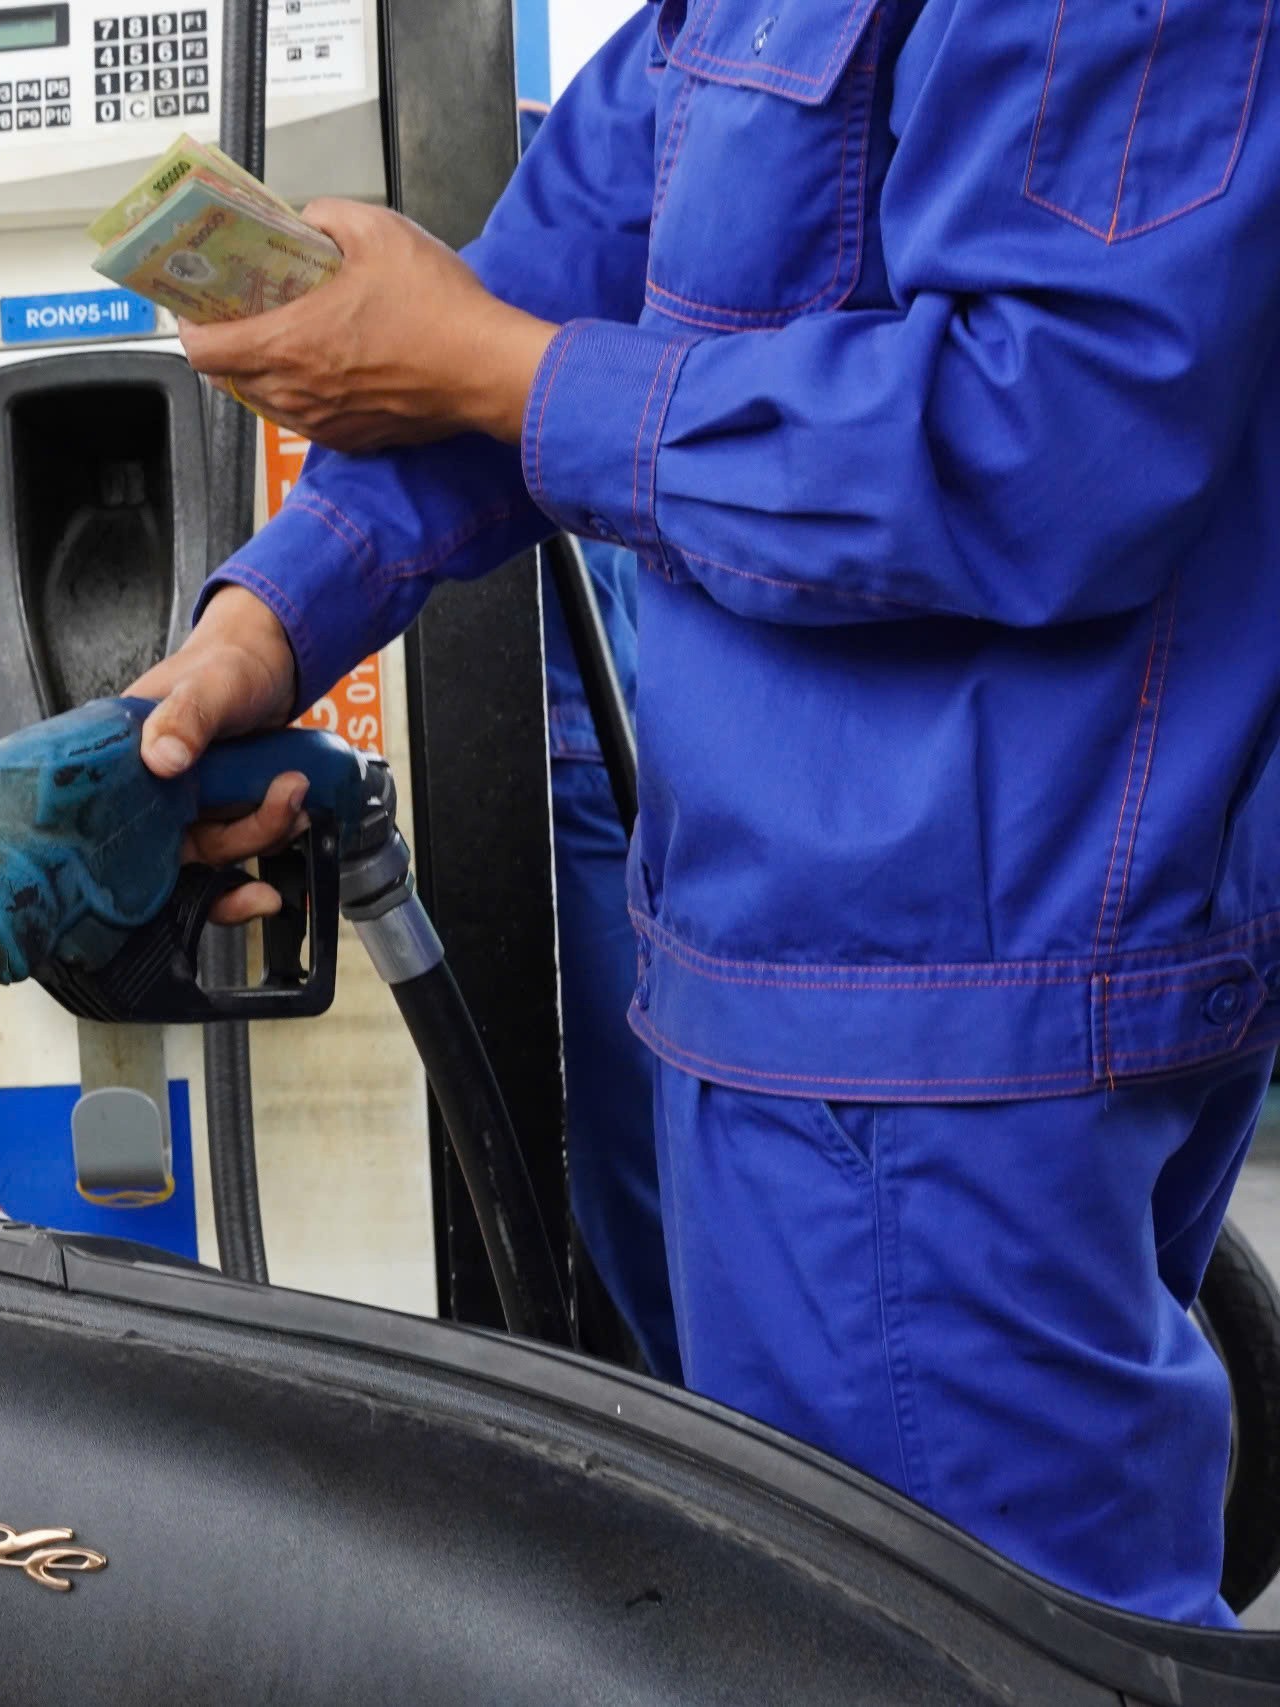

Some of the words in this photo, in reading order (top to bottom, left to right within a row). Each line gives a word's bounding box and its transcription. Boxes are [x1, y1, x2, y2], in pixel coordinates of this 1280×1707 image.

[102, 21, 113, 38] 7
[129, 18, 141, 36] 8
[158, 15, 171, 33] 9
[185, 15, 201, 28] F1
[100, 48, 113, 66] 4
[129, 46, 142, 63] 5
[159, 43, 171, 61] 6
[186, 42, 204, 56] F2
[19, 82, 39, 99] P4
[47, 81, 68, 97] P5
[102, 76, 111, 93] 1
[130, 73, 143, 90] 2
[159, 71, 172, 88] 3
[187, 70, 204, 83] F3
[19, 110, 39, 127] P9
[47, 108, 70, 124] P10
[101, 103, 115, 120] 0
[130, 100, 145, 118] C
[187, 97, 205, 110] F4
[25, 301, 129, 328] RON95-III
